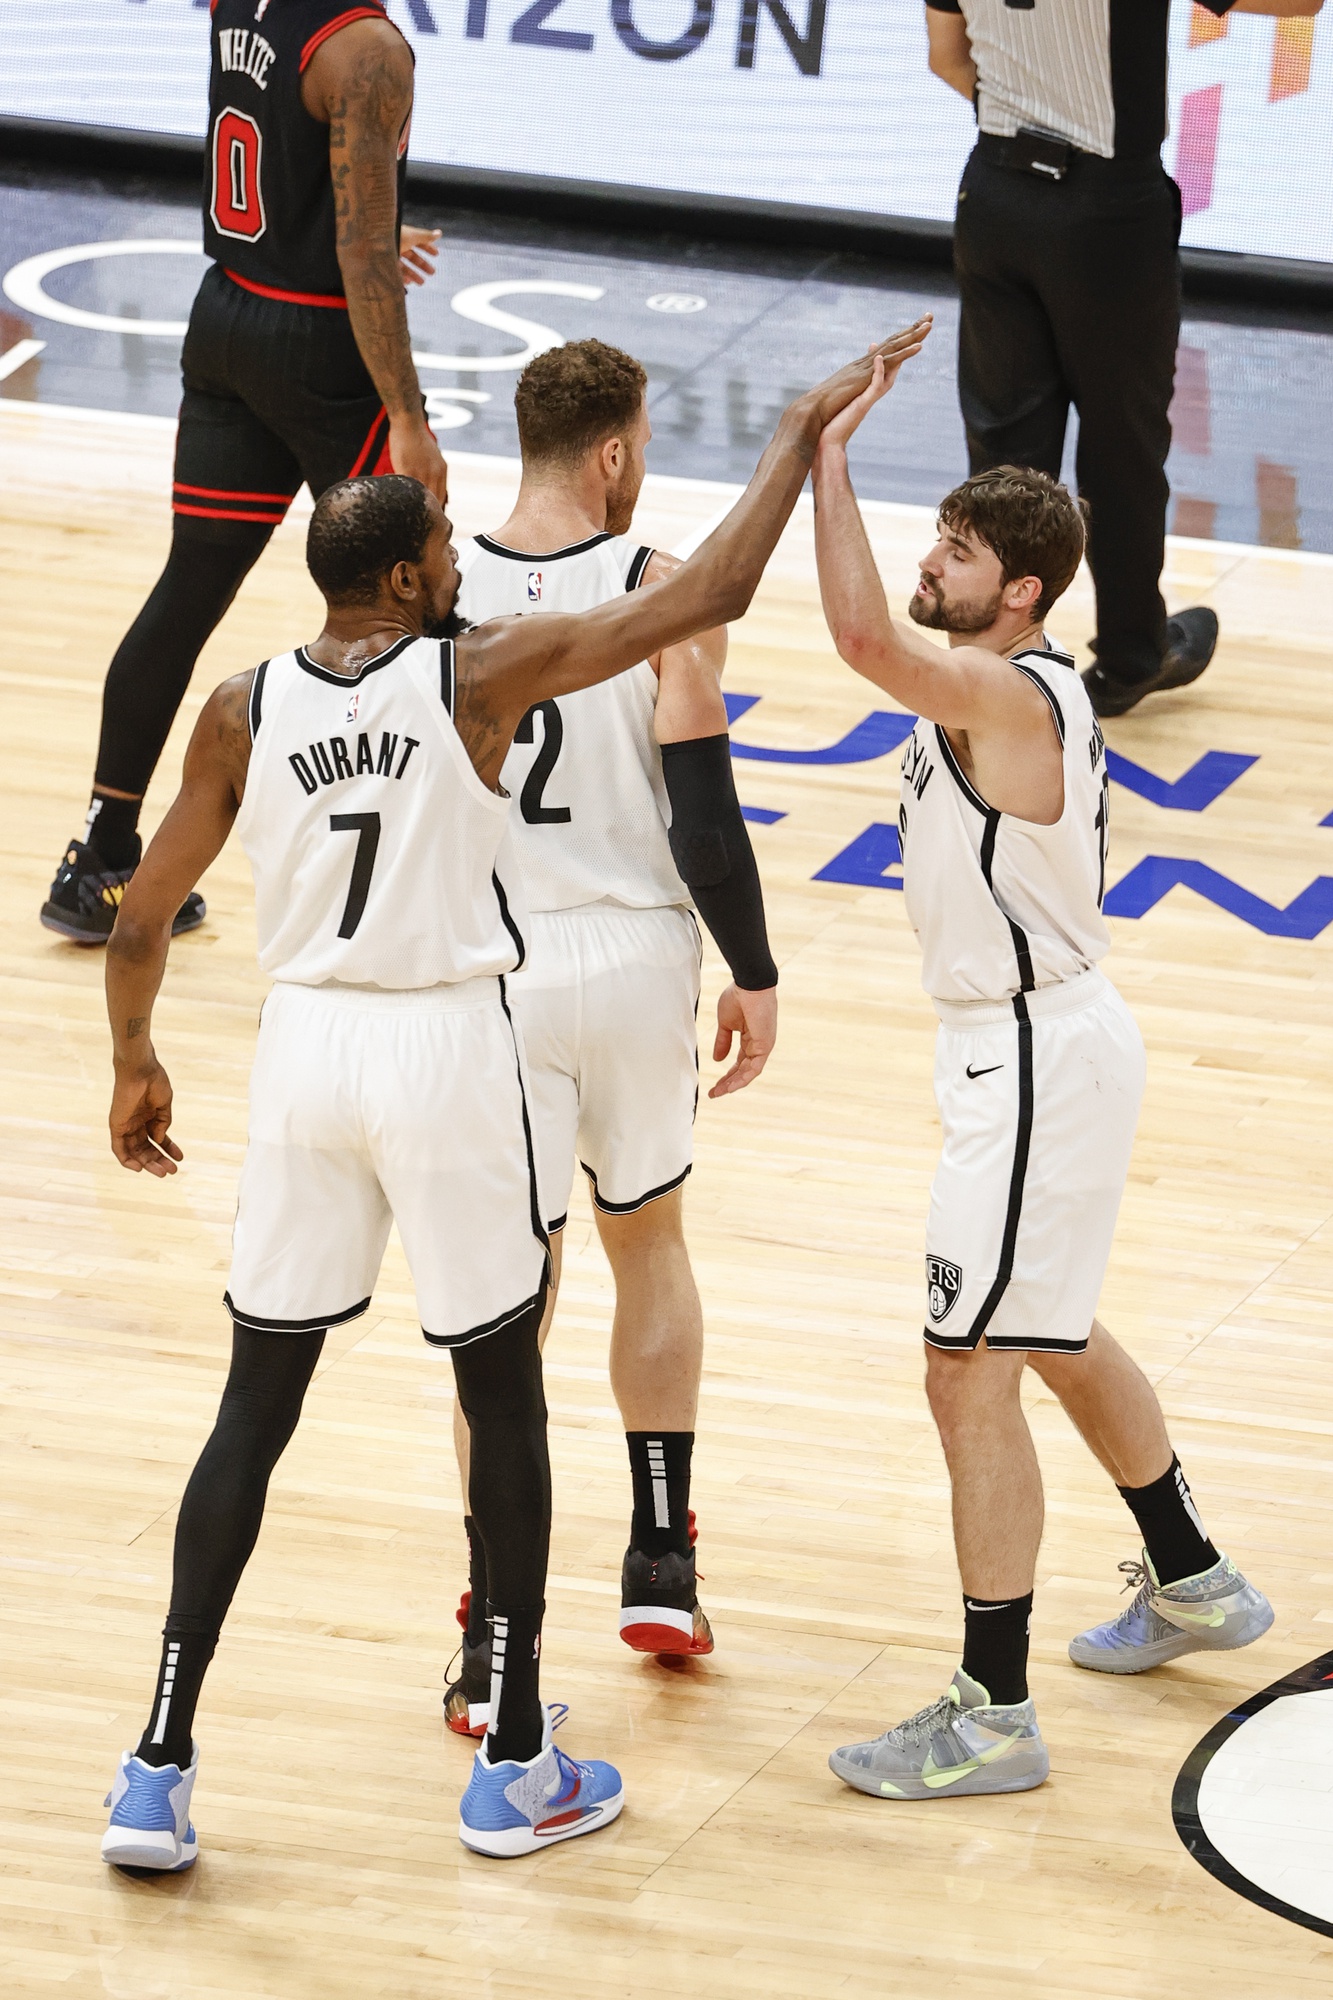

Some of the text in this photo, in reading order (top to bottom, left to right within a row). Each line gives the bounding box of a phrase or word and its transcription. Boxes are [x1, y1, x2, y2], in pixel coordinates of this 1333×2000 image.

[218, 27, 277, 91] WHITE
[210, 105, 267, 243] 0
[288, 731, 421, 796] DURANT
[513, 699, 572, 825] 2
[329, 811, 382, 940] 7
[927, 1259, 958, 1291] ETS
